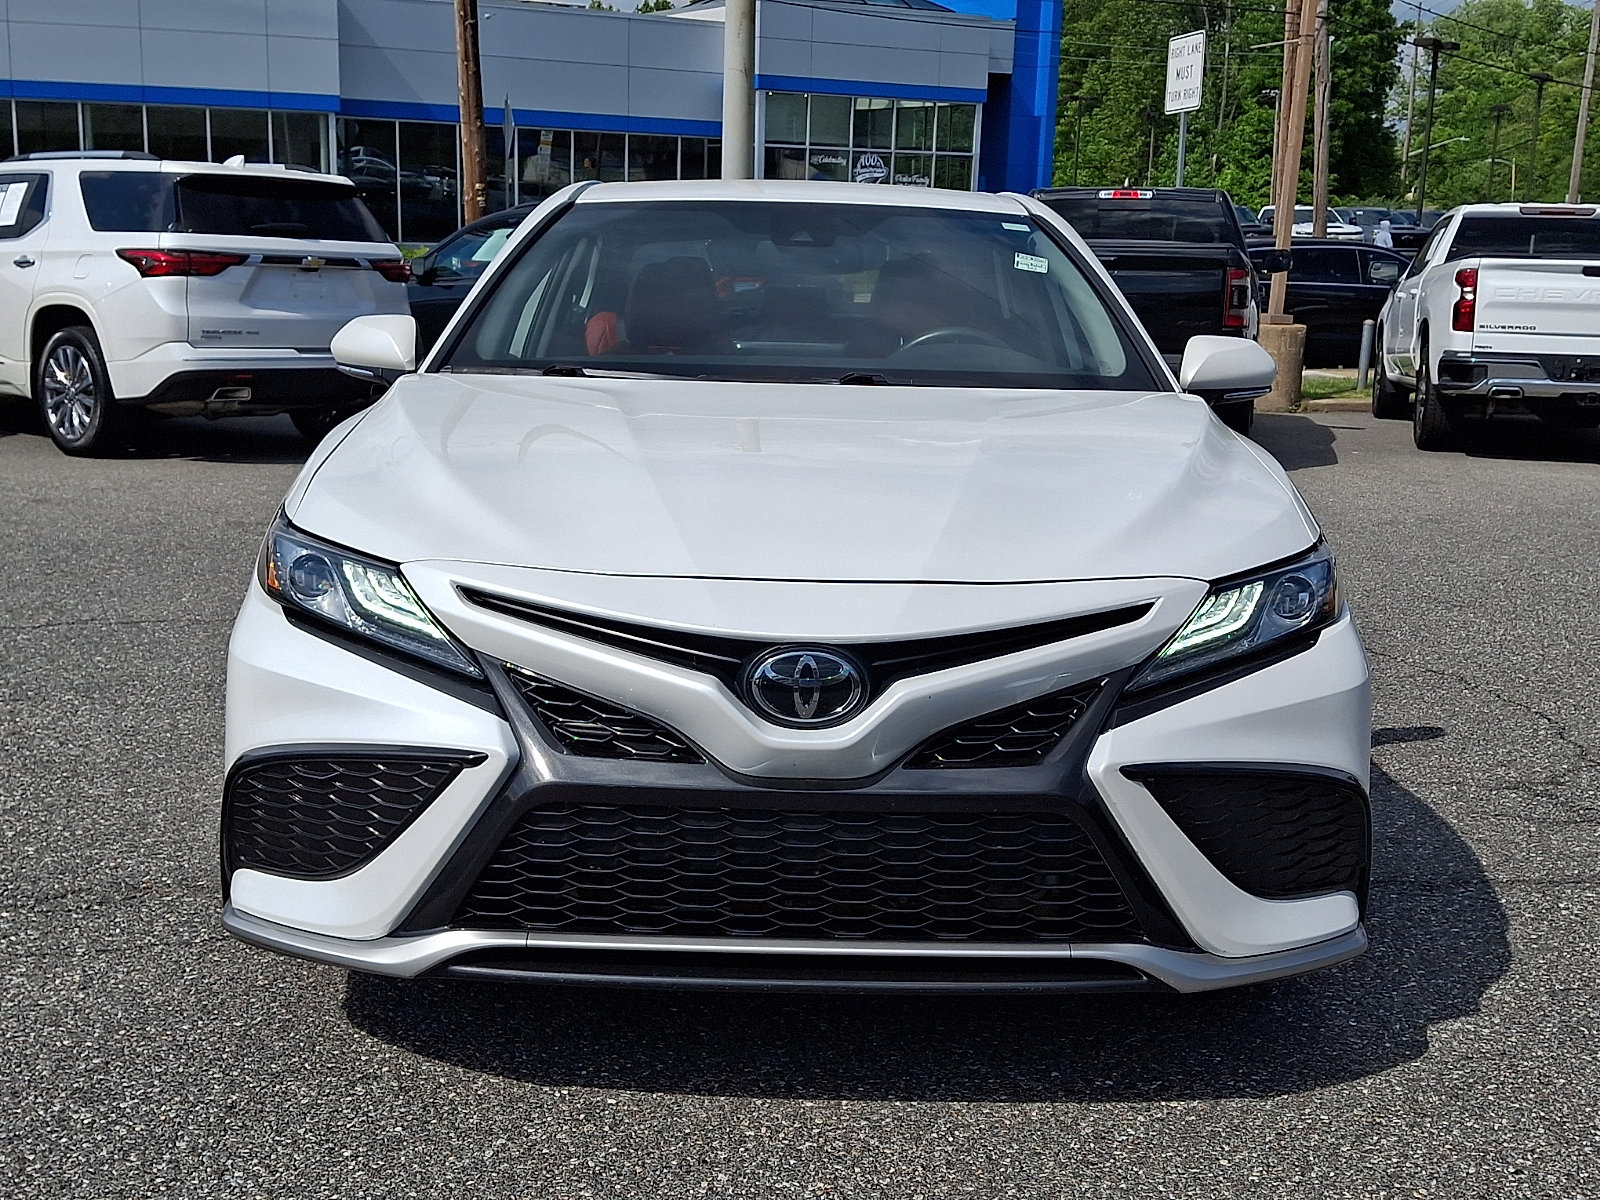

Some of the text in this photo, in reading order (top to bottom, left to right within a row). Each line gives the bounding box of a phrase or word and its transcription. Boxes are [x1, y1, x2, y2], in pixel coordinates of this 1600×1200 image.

[1171, 42, 1202, 59] RIGHT LANE
[1175, 64, 1194, 81] MUST
[1168, 86, 1199, 103] TURN RIGHT
